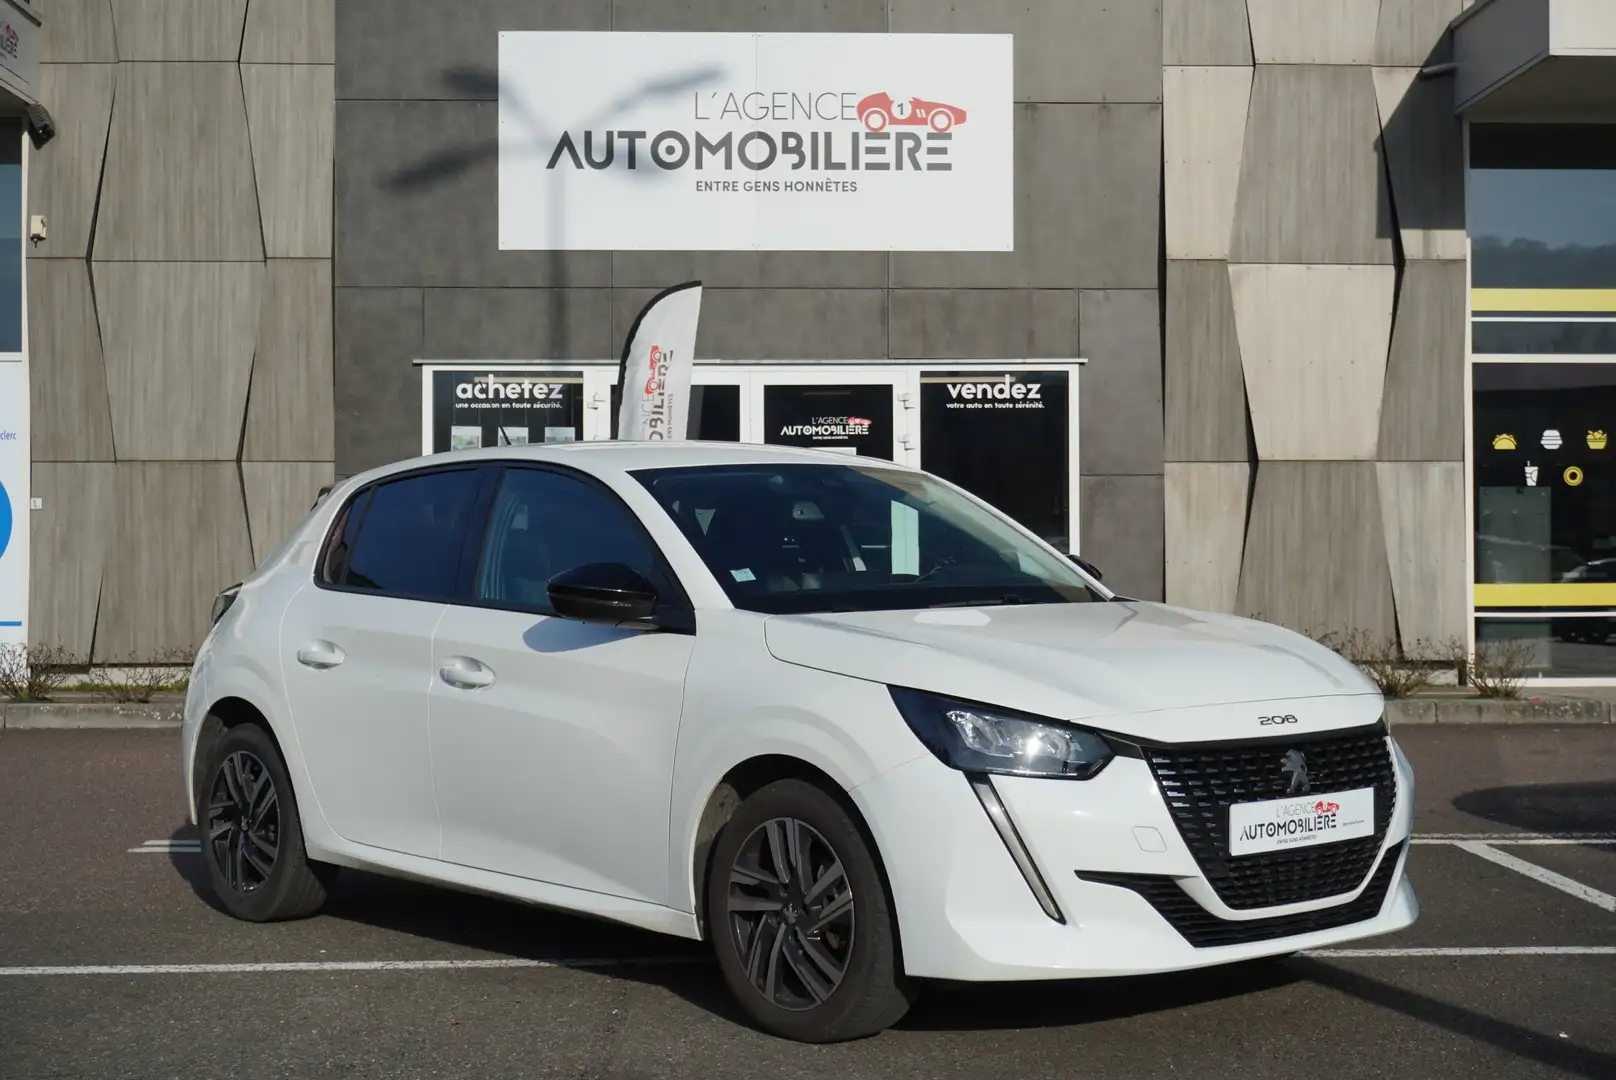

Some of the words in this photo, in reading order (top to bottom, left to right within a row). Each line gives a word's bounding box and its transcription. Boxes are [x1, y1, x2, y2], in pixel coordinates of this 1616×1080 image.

[694, 91, 858, 121] L'AGENCE
[896, 102, 905, 116] 1
[695, 180, 740, 193] ENTRE
[742, 180, 781, 193] GENS
[784, 177, 858, 193] HONNÊTES
[455, 373, 564, 399] achetez
[946, 373, 1041, 399] vendez
[533, 400, 563, 408] sécurité.
[1015, 400, 1045, 409] sérénité.
[1258, 714, 1298, 726] 208
